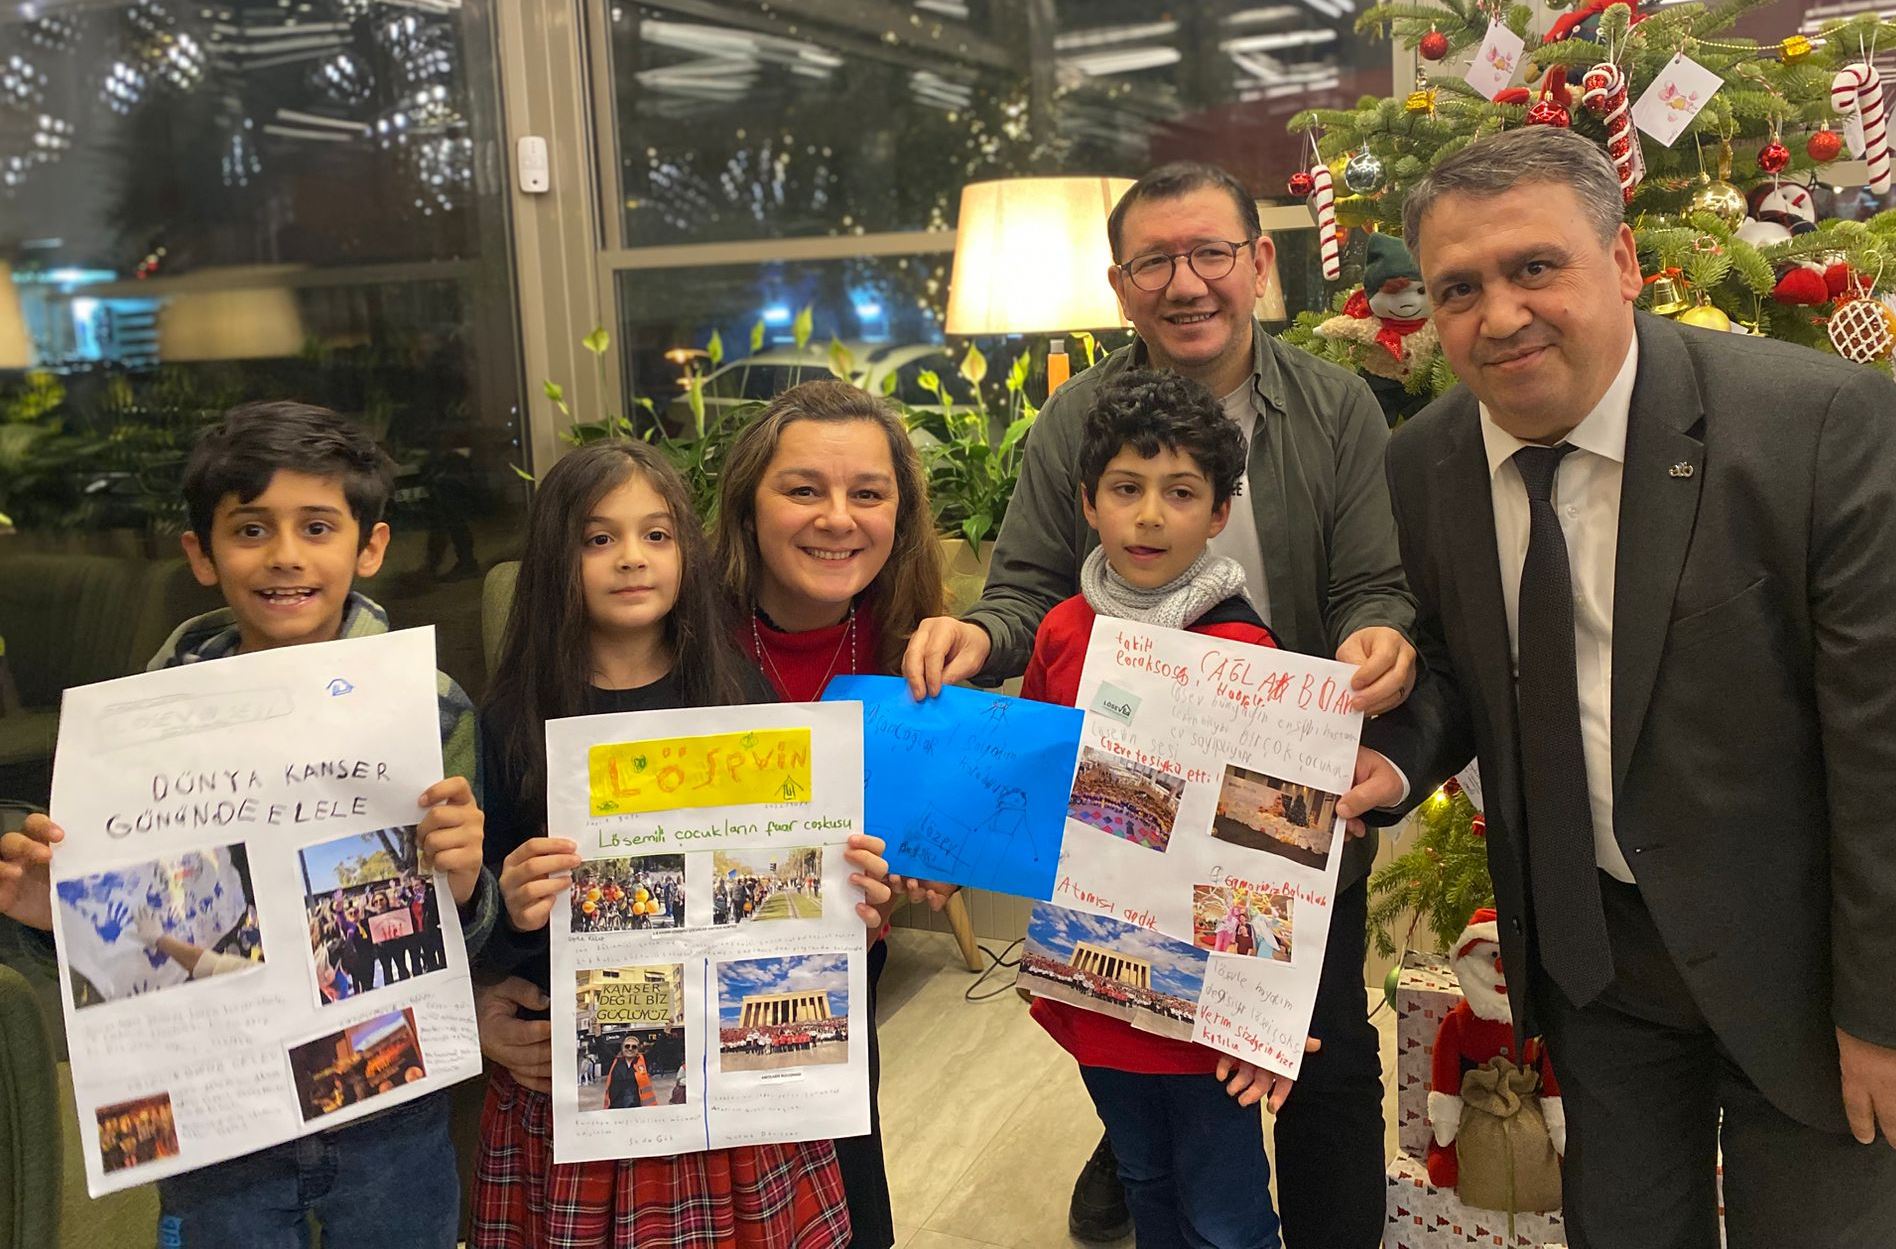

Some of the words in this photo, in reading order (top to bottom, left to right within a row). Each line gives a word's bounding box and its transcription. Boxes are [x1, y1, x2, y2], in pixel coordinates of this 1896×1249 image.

[153, 769, 262, 802] DÜNYA
[284, 760, 390, 786] KANSER
[603, 983, 661, 995] KANSER
[596, 1009, 671, 1022] GÜÇLÜYÜZ
